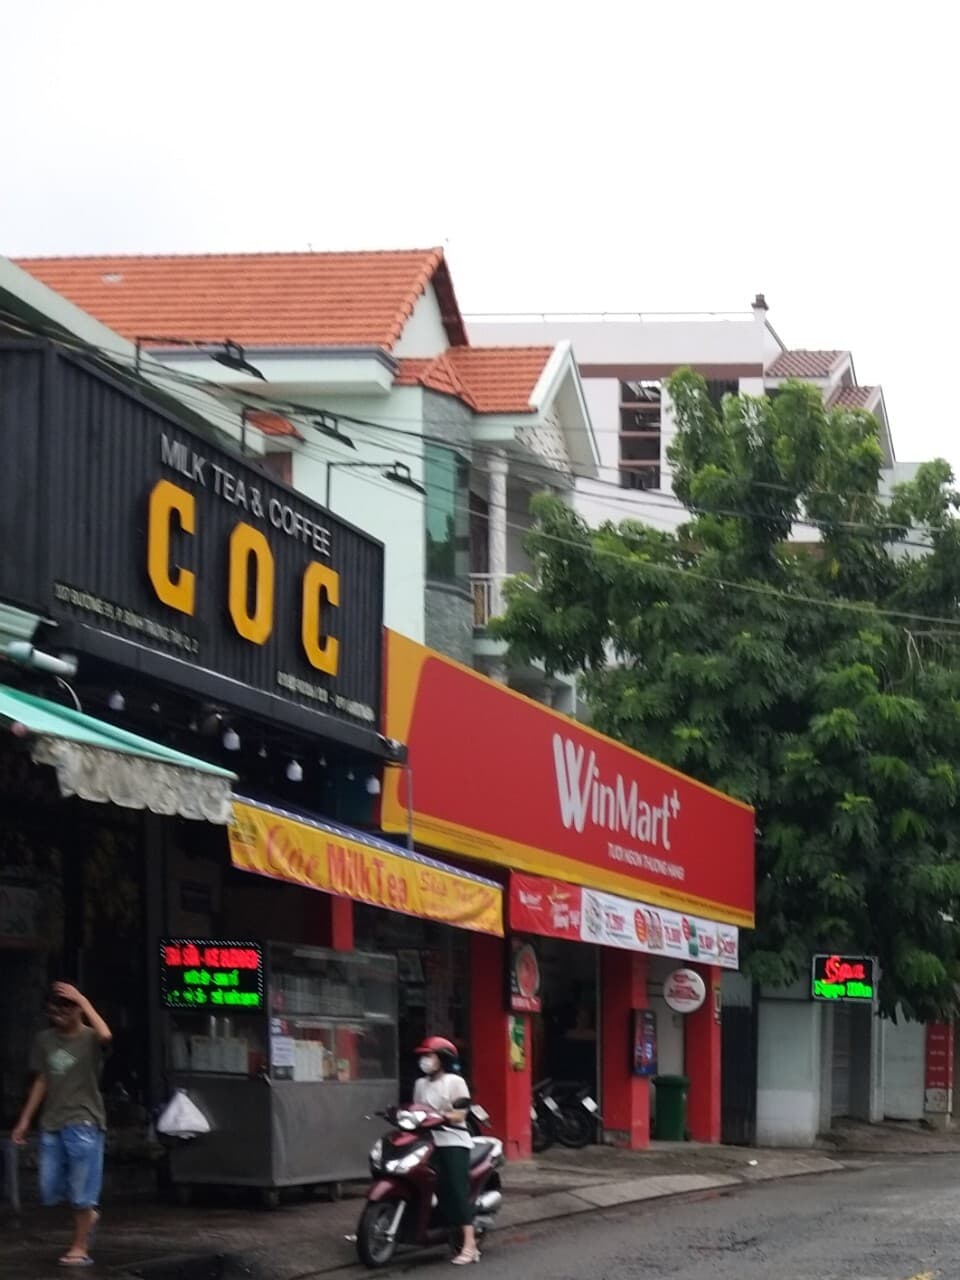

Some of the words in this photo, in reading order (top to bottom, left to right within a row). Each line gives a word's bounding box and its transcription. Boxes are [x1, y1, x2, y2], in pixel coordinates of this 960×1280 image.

[161, 432, 206, 487] MILK
[211, 463, 249, 511] TEA
[268, 498, 332, 557] COFFEE
[148, 478, 340, 678] COC
